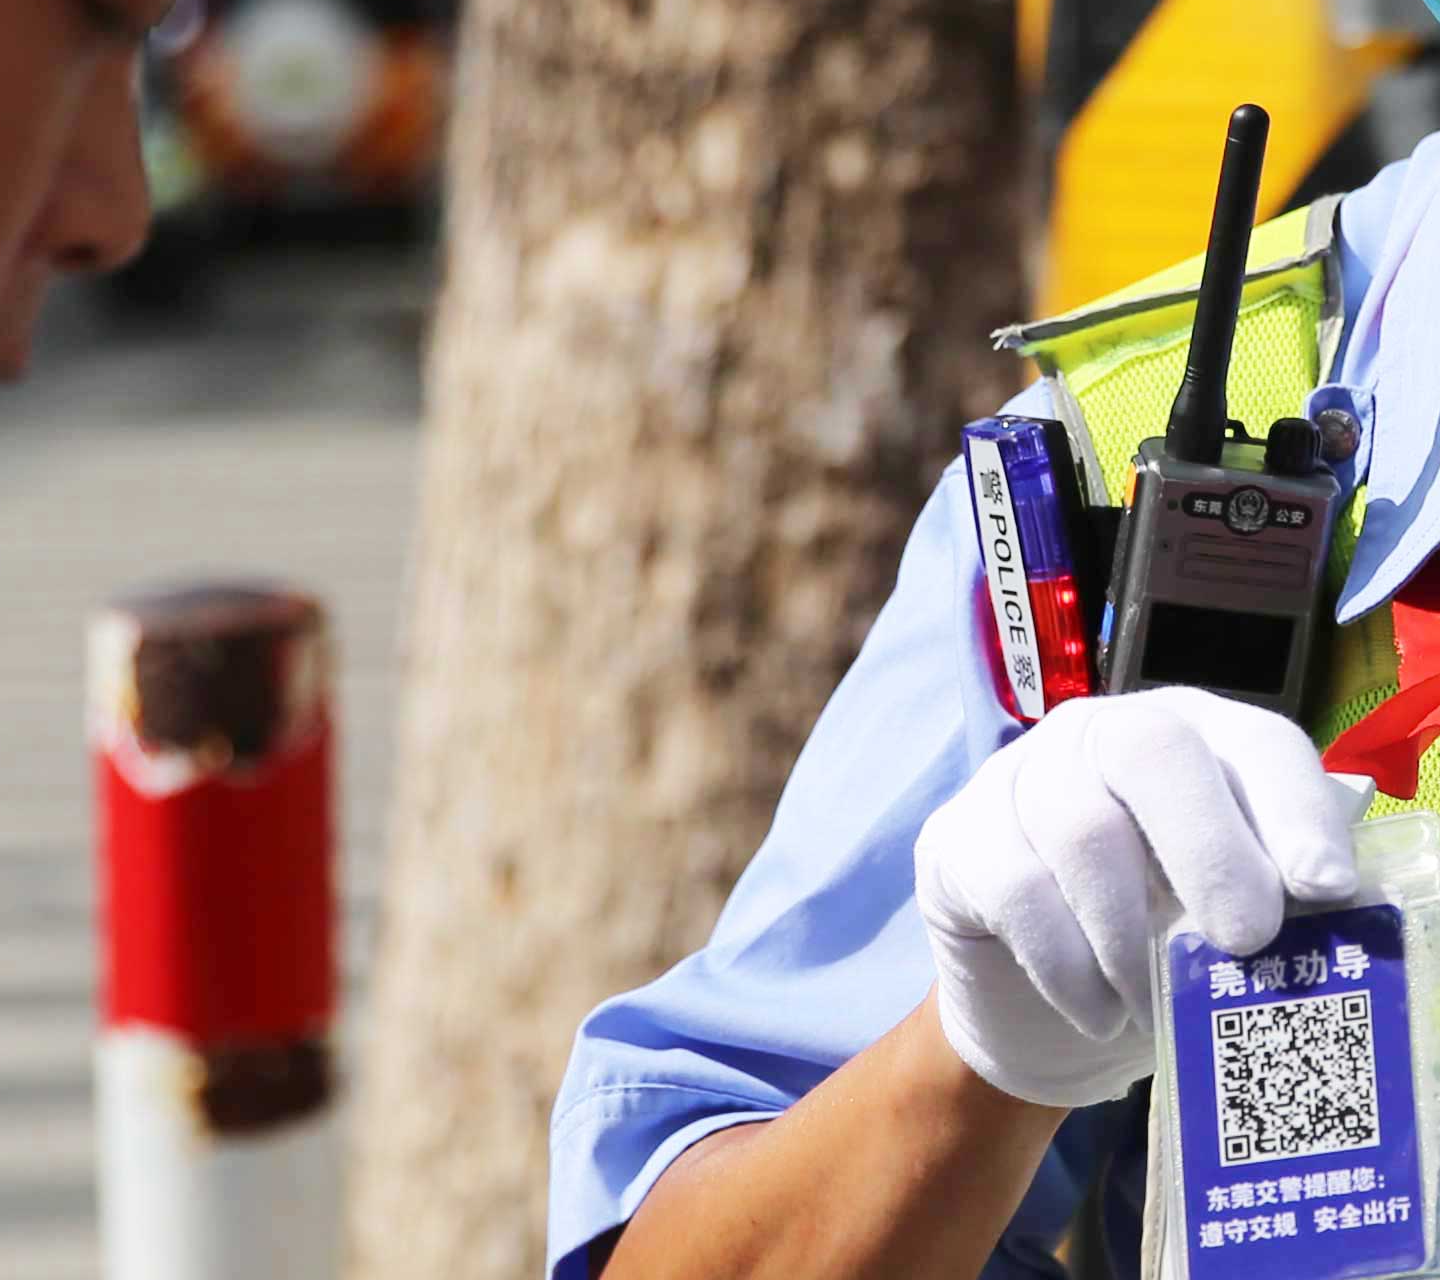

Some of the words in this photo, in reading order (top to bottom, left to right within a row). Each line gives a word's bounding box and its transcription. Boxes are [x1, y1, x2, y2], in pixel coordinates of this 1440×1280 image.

[1192, 499, 1223, 516] 东莞
[1275, 508, 1306, 525] 公安
[989, 512, 1029, 646] POLICE
[1208, 943, 1371, 1000] 莞微劝导
[1199, 1211, 1299, 1249] 遵守交规
[1313, 1195, 1412, 1233] 安全出行
